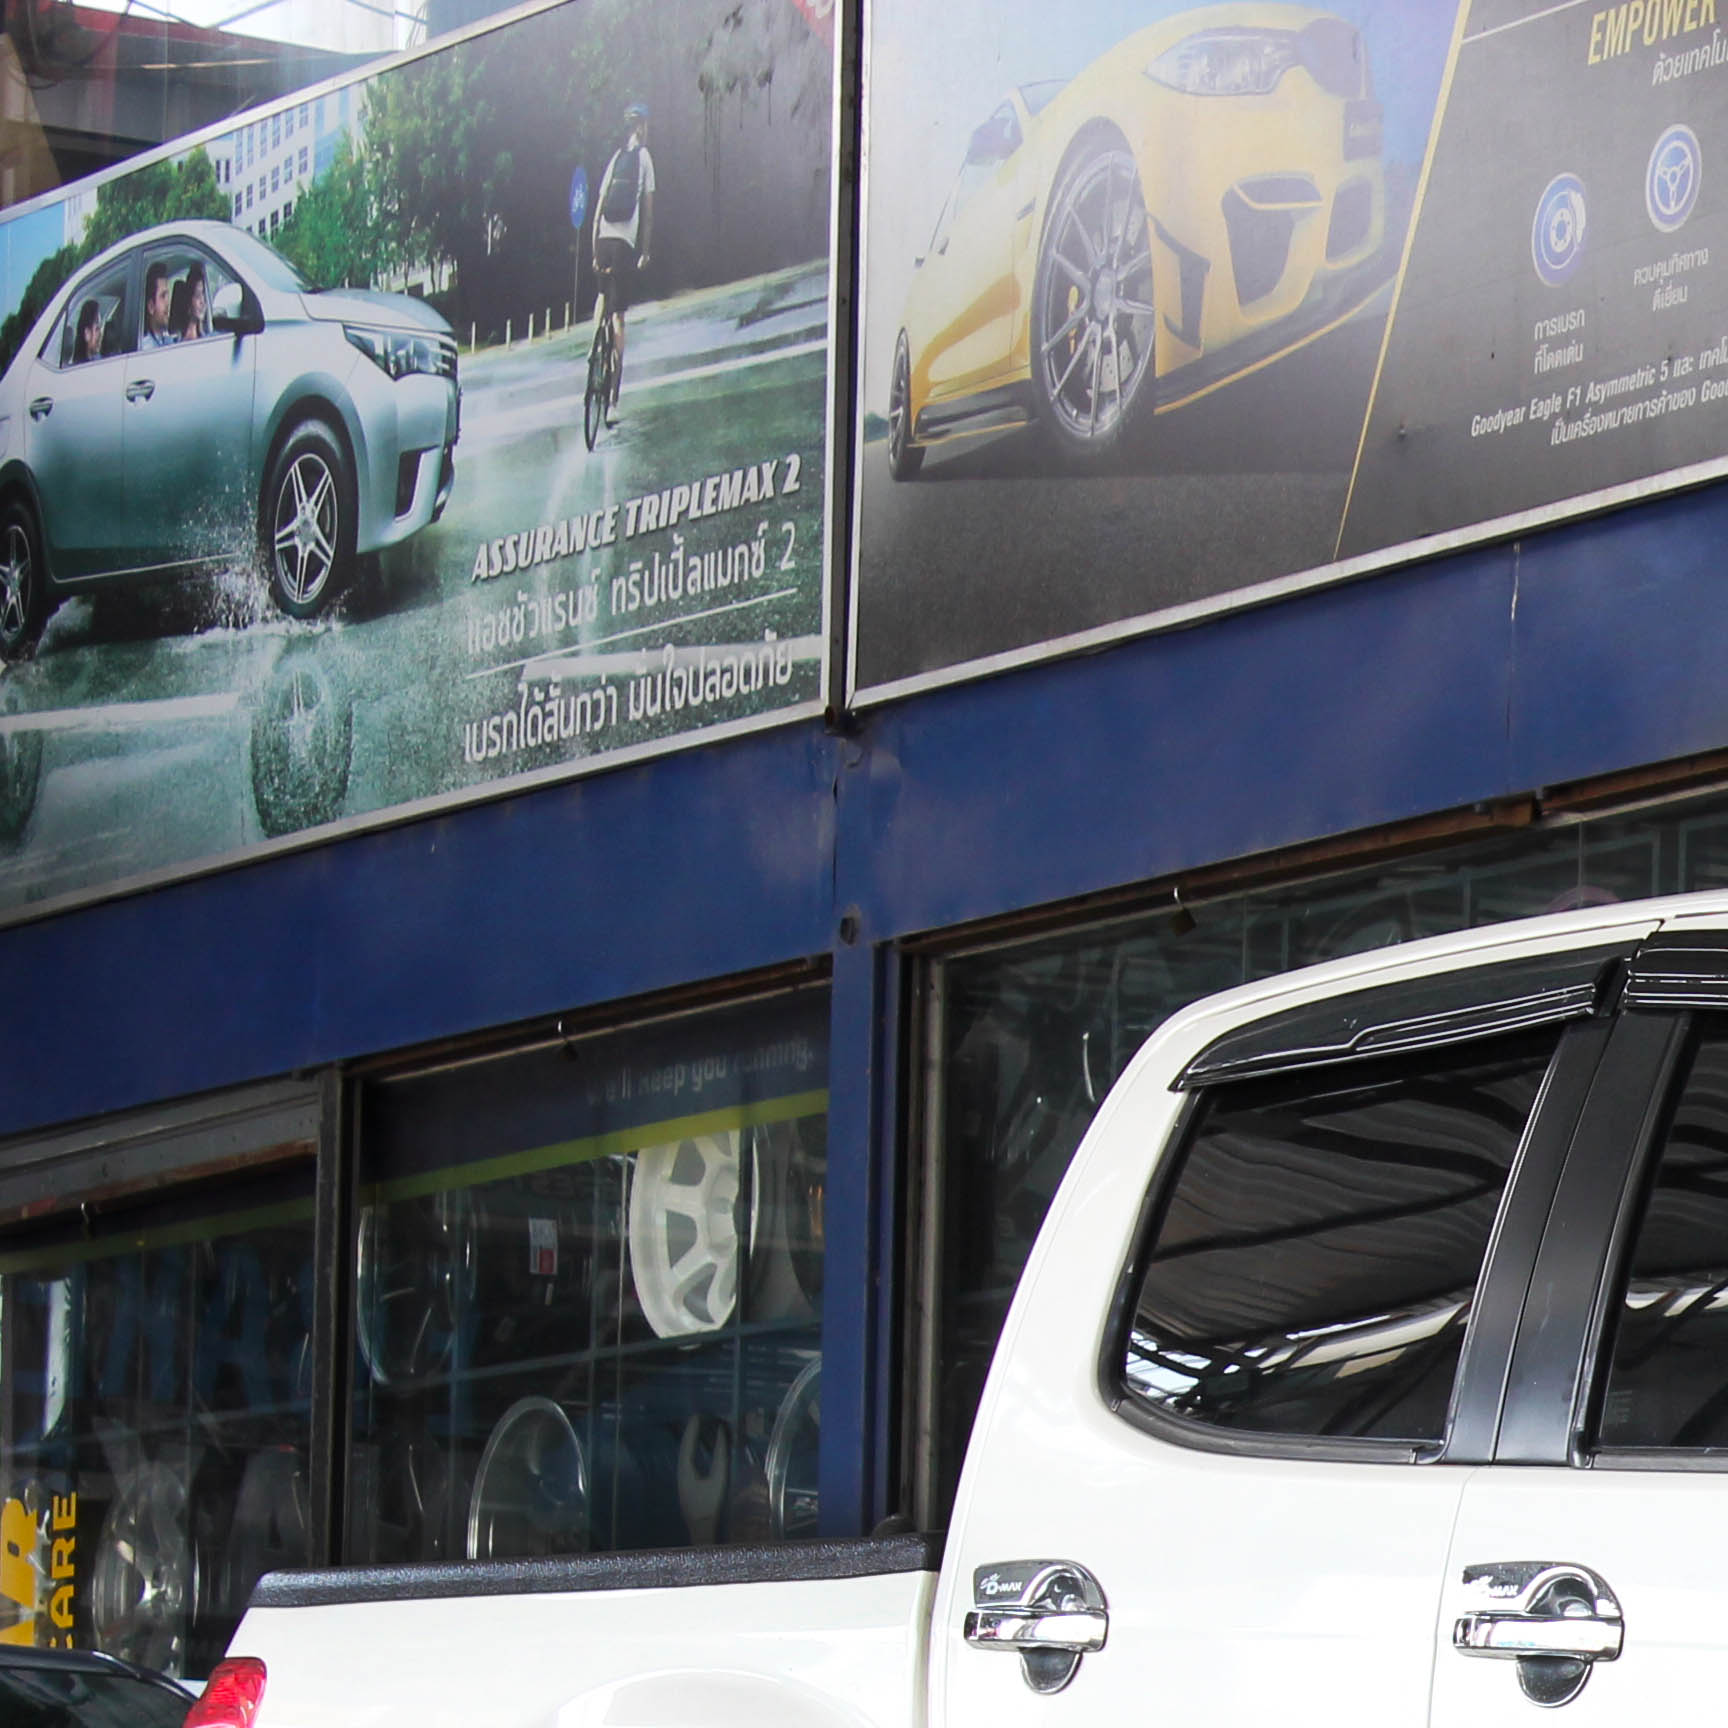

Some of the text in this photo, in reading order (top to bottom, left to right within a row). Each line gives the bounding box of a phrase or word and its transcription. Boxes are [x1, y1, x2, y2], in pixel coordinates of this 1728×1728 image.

[1471, 405, 1526, 437] Goodyear
[1529, 393, 1562, 421] Eagle
[1566, 388, 1582, 410] F1
[1585, 366, 1656, 407] Asymmetric
[1659, 359, 1669, 382] 5
[472, 453, 802, 583] ASSURANCE TRIPLEMAX 2
[779, 520, 797, 572] 2
[463, 674, 618, 764] เบรกได้สั้นกว่า
